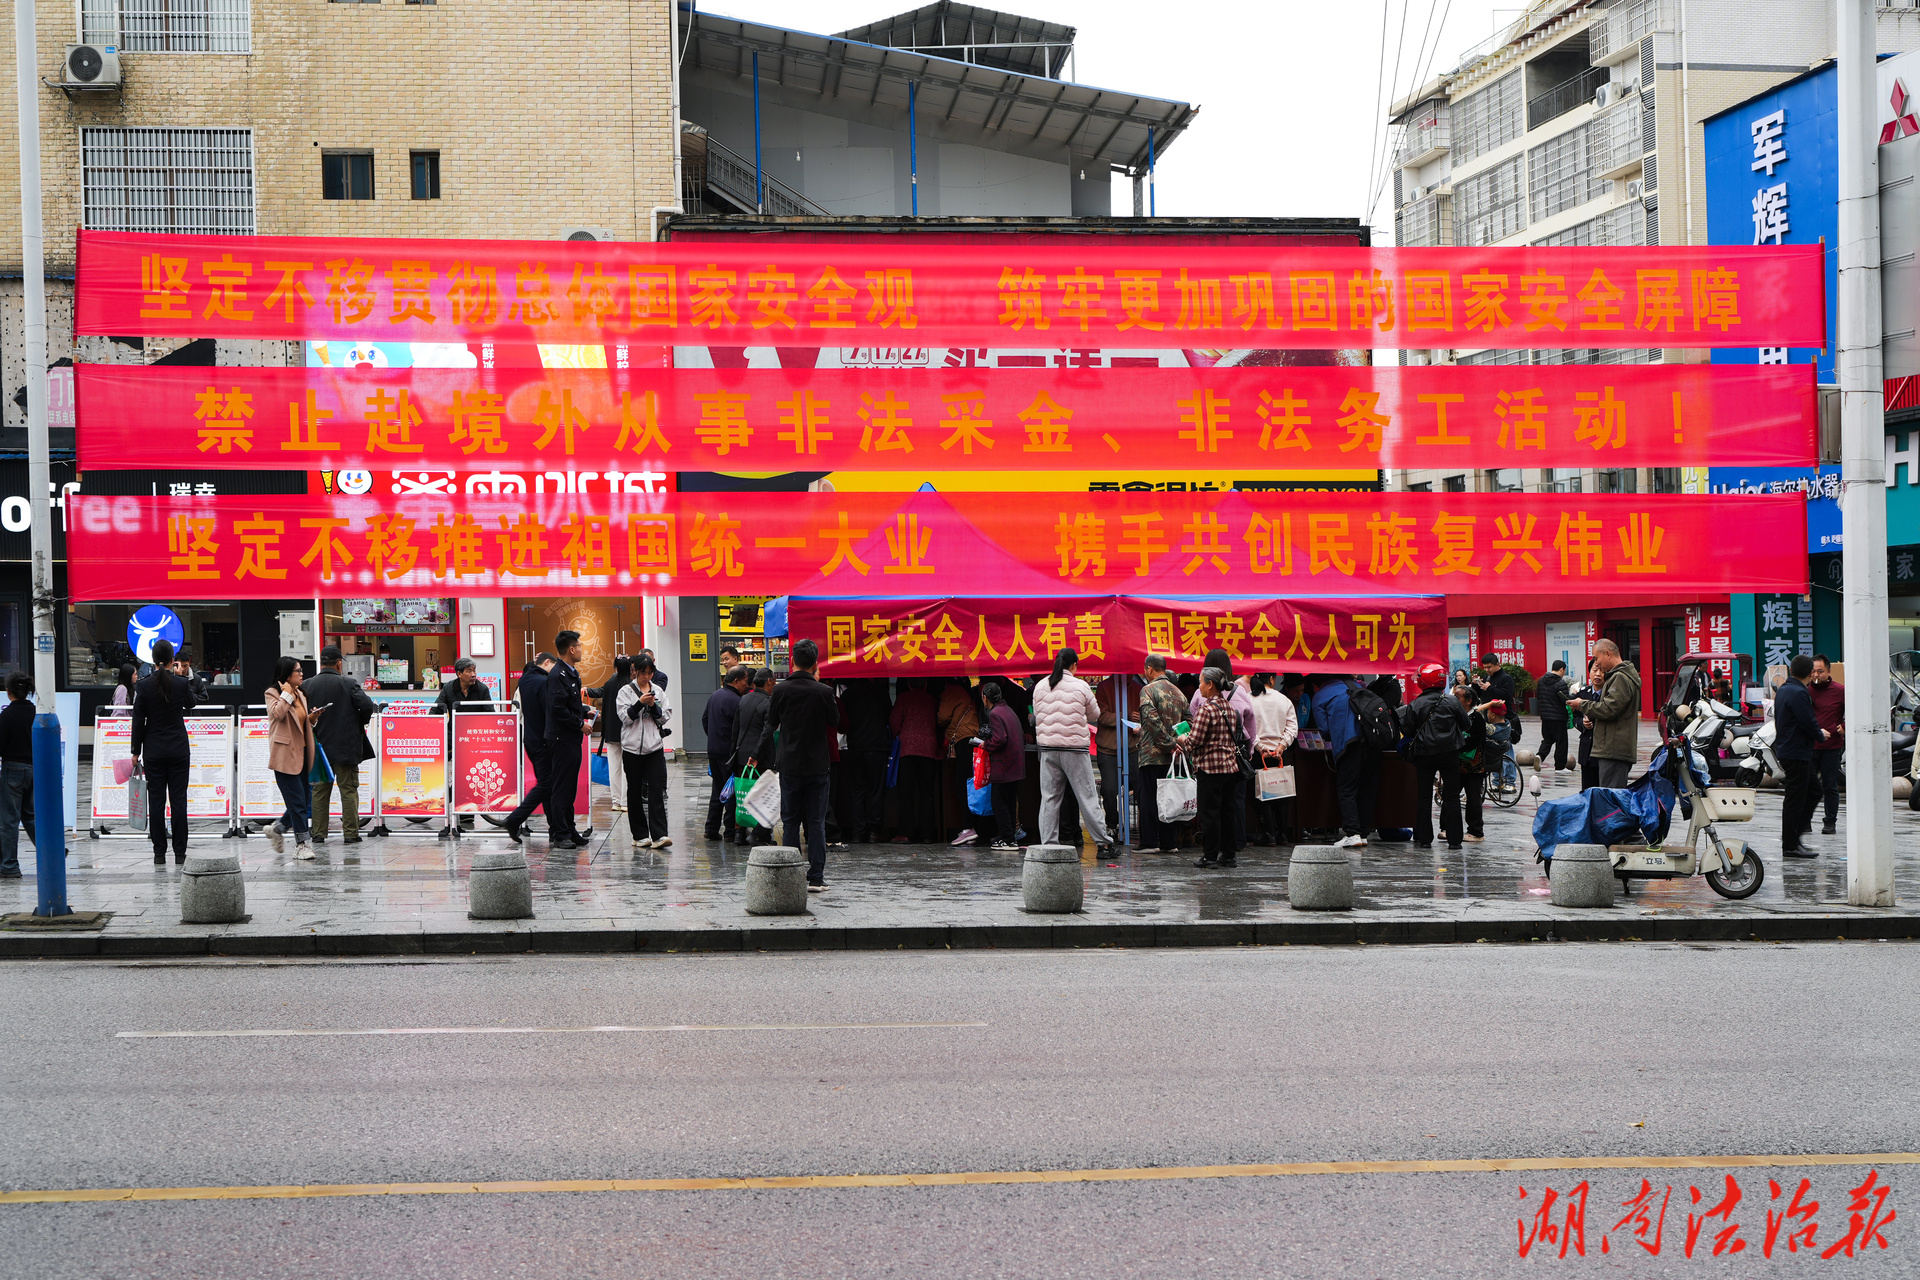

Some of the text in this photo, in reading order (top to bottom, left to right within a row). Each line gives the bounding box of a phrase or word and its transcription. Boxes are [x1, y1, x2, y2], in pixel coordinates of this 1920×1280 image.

[140, 254, 1742, 334] 坚定不移贯彻总体国家安全观 筑牢更加巩固的国家安全屏障
[194, 386, 1686, 456] 禁止赴境外从事非法采金、非法务工活动！
[167, 511, 1668, 581] 坚定不移推进祖国统一大业 携手共创民族复兴伟业
[826, 611, 1417, 664] 国家安全人人有责 国家安全人人可为
[1763, 594, 1793, 669] 辉家
